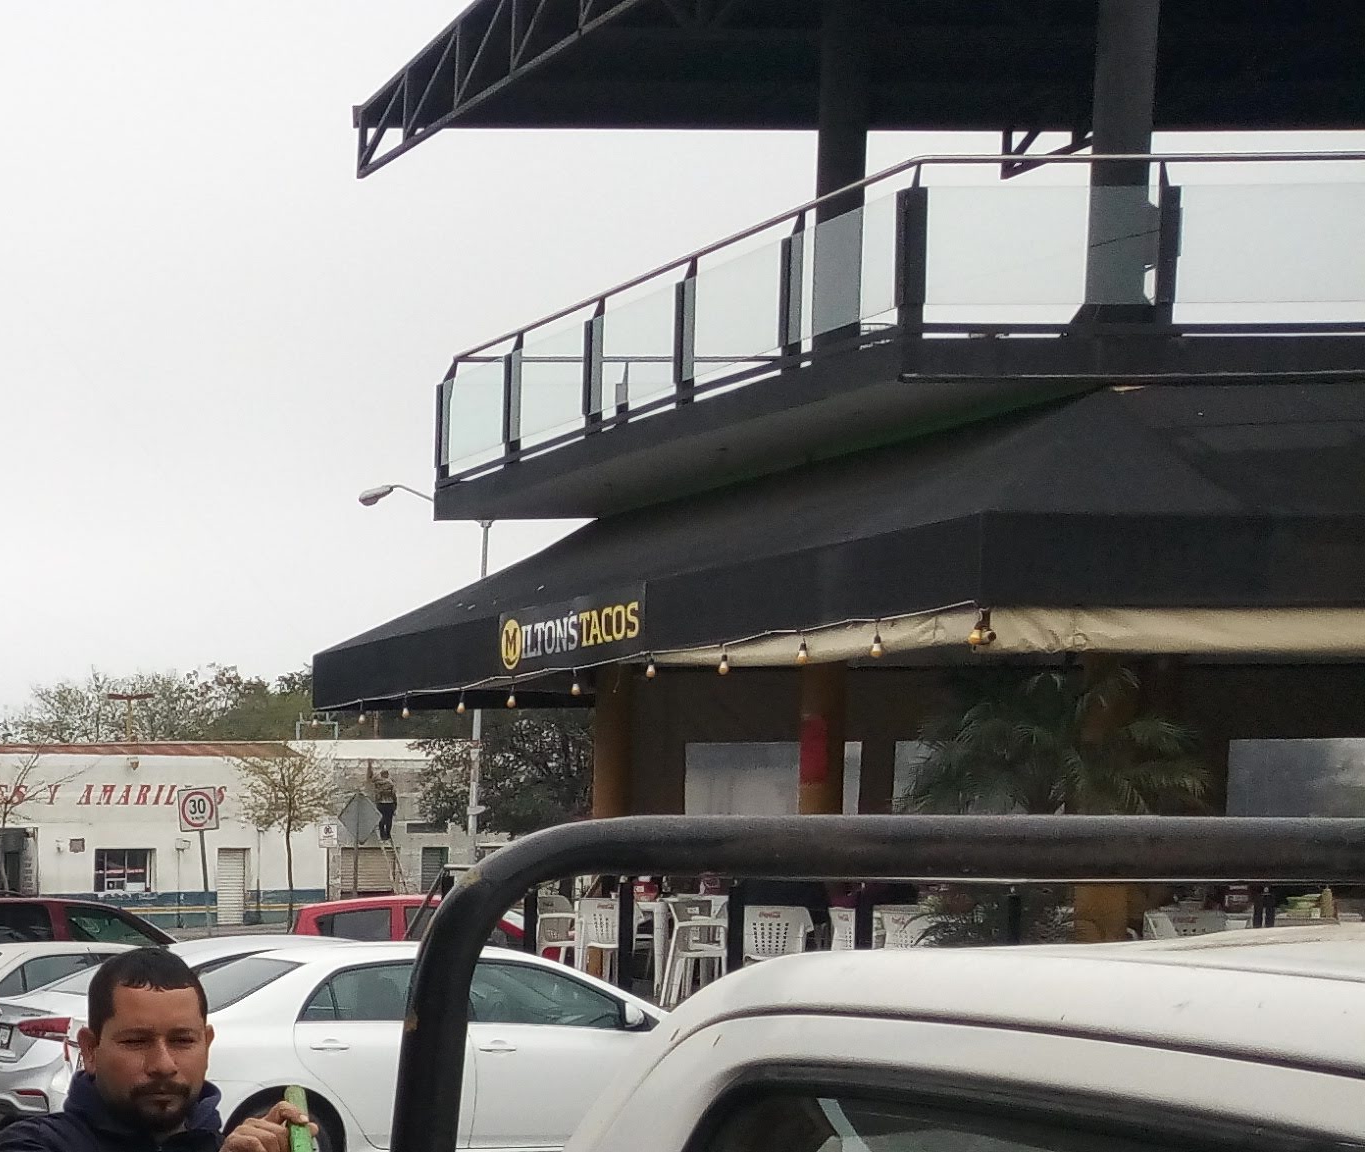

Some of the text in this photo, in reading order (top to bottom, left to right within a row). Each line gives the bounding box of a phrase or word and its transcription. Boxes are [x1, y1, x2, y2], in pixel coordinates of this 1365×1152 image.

[579, 601, 640, 648] TACOS
[45, 783, 62, 805] Y
[76, 784, 227, 806] AMARILS
[189, 798, 207, 815] 30
